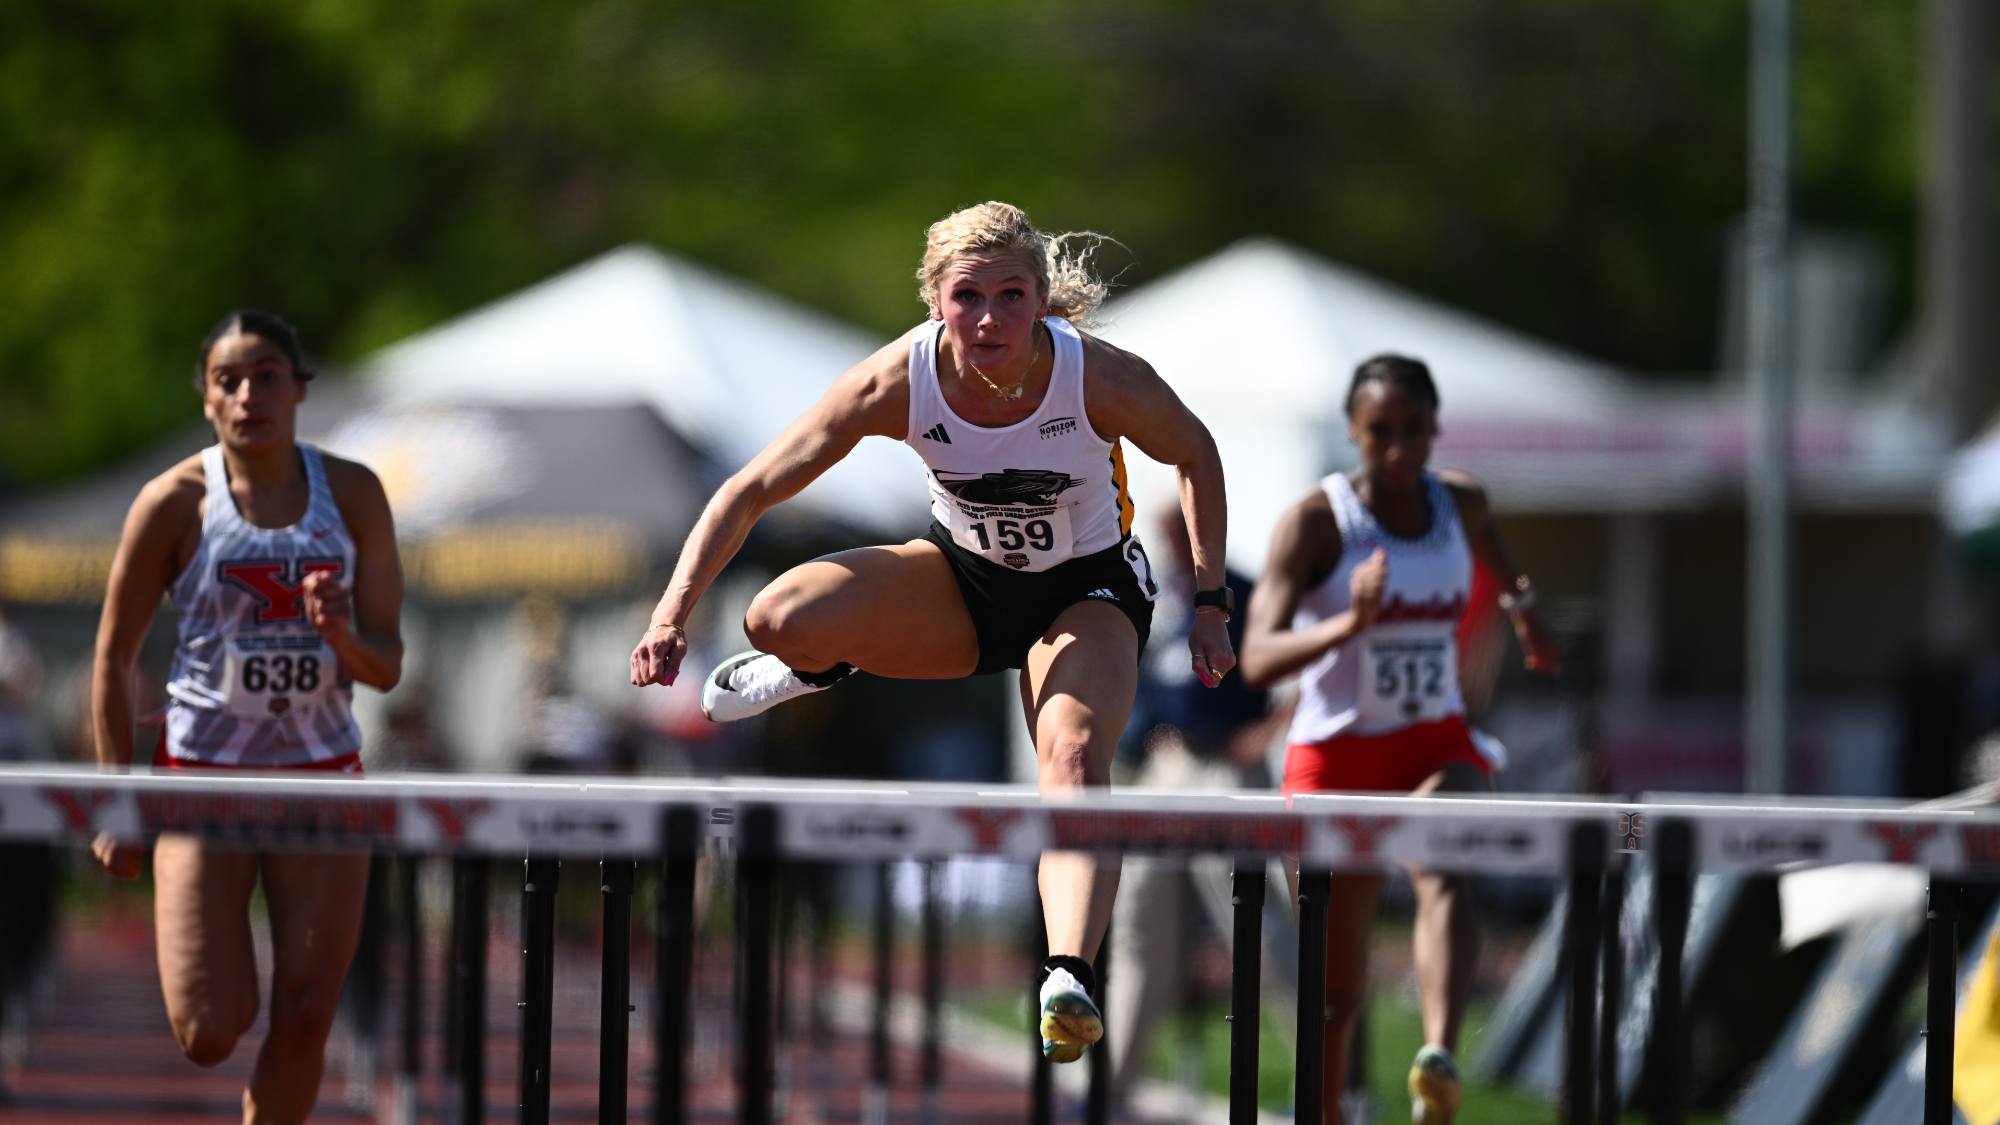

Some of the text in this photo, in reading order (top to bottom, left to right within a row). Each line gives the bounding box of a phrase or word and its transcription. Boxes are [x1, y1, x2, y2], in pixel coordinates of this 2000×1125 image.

[1040, 420, 1076, 435] HORIZON
[1040, 427, 1077, 440] LEAGUE
[961, 508, 979, 519] TRACK
[970, 519, 1054, 551] 159
[1127, 541, 1158, 597] 2
[218, 555, 345, 625] Y
[242, 655, 320, 693] 638
[1376, 660, 1446, 698] 512
